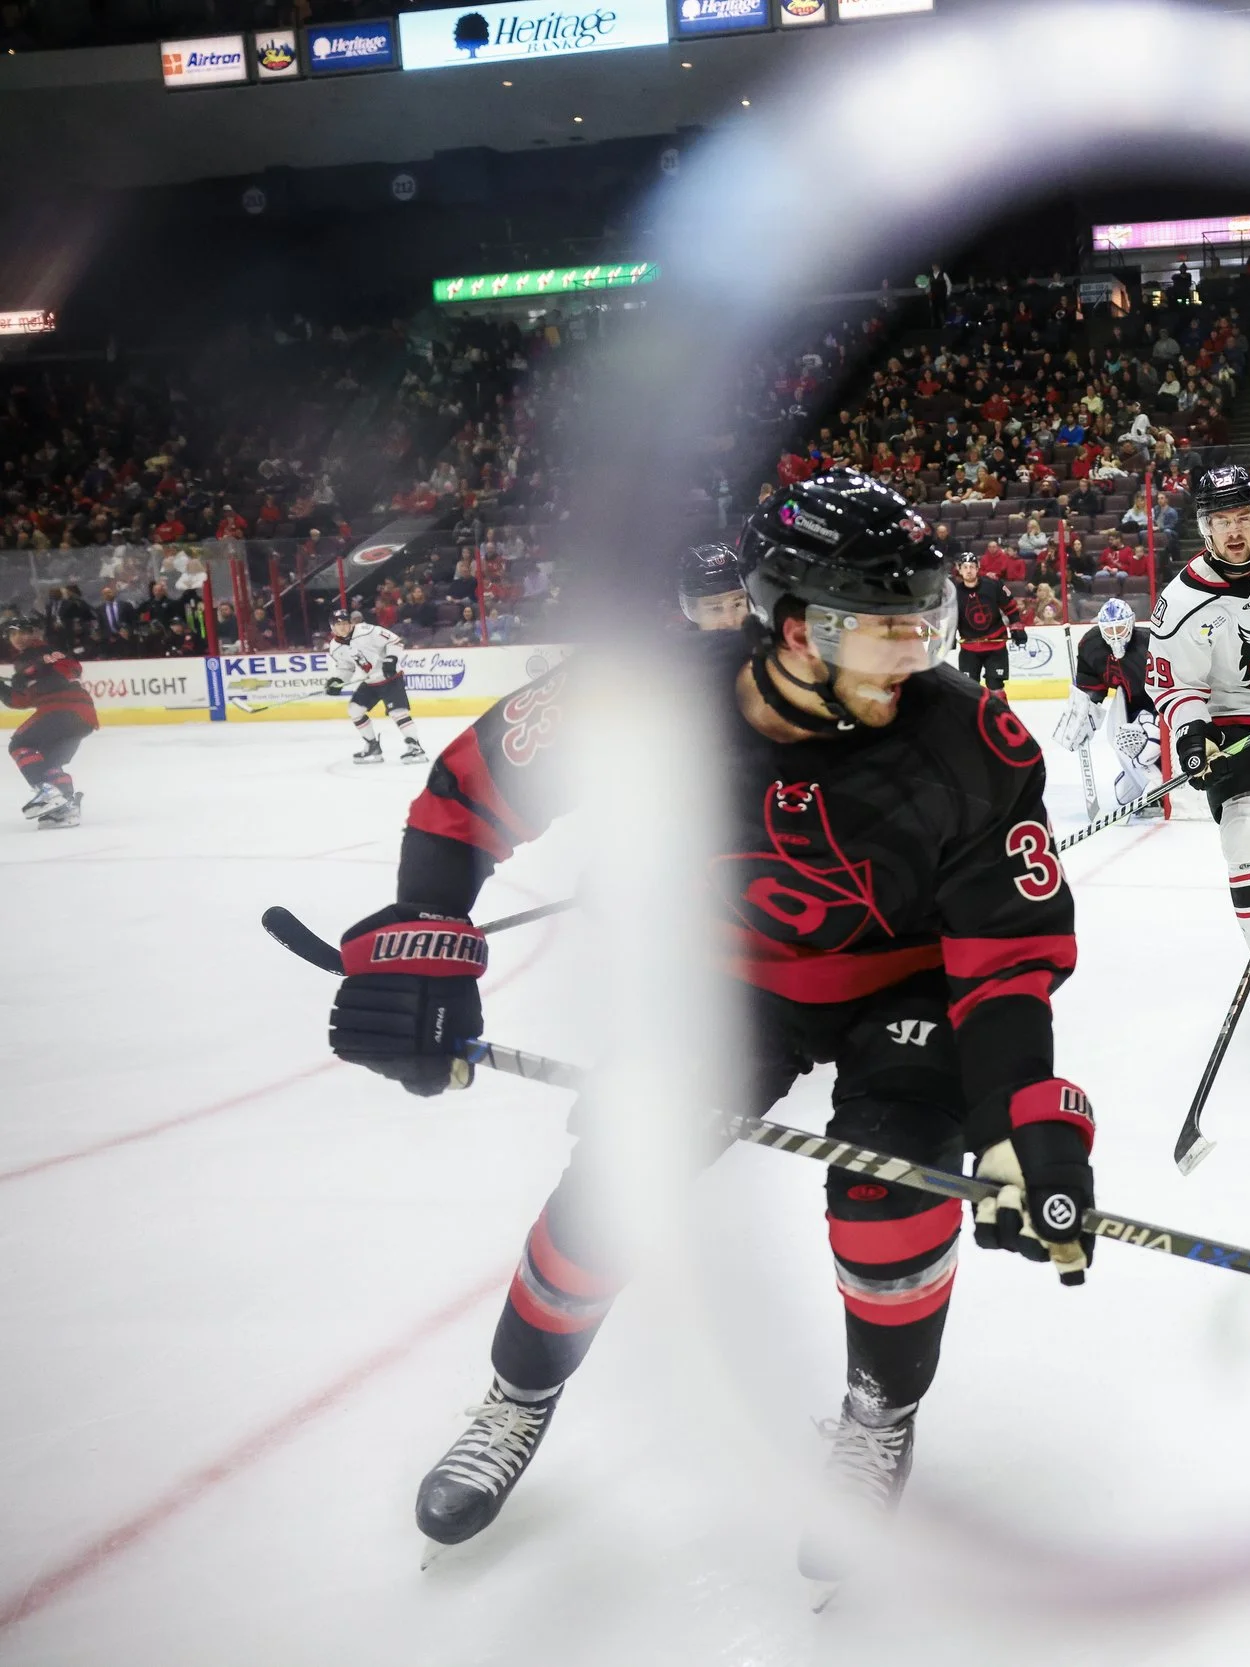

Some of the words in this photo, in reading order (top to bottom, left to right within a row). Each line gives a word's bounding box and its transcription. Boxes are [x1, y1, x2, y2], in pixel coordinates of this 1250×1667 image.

[494, 9, 616, 48] Heritage
[331, 35, 387, 53] Heritage
[527, 39, 576, 53] BANK
[187, 52, 241, 67] Airtron
[225, 654, 329, 676] KELSE
[400, 654, 426, 668] bert
[430, 653, 464, 671] Jones
[1145, 652, 1175, 689] 29
[82, 680, 128, 698] oors
[132, 677, 187, 696] LIGHT
[403, 674, 453, 690] LUMBING
[1005, 820, 1063, 901] 3
[370, 930, 488, 966] WARRI
[434, 1006, 446, 1043] ALPHA
[1095, 1218, 1173, 1254] PHA
